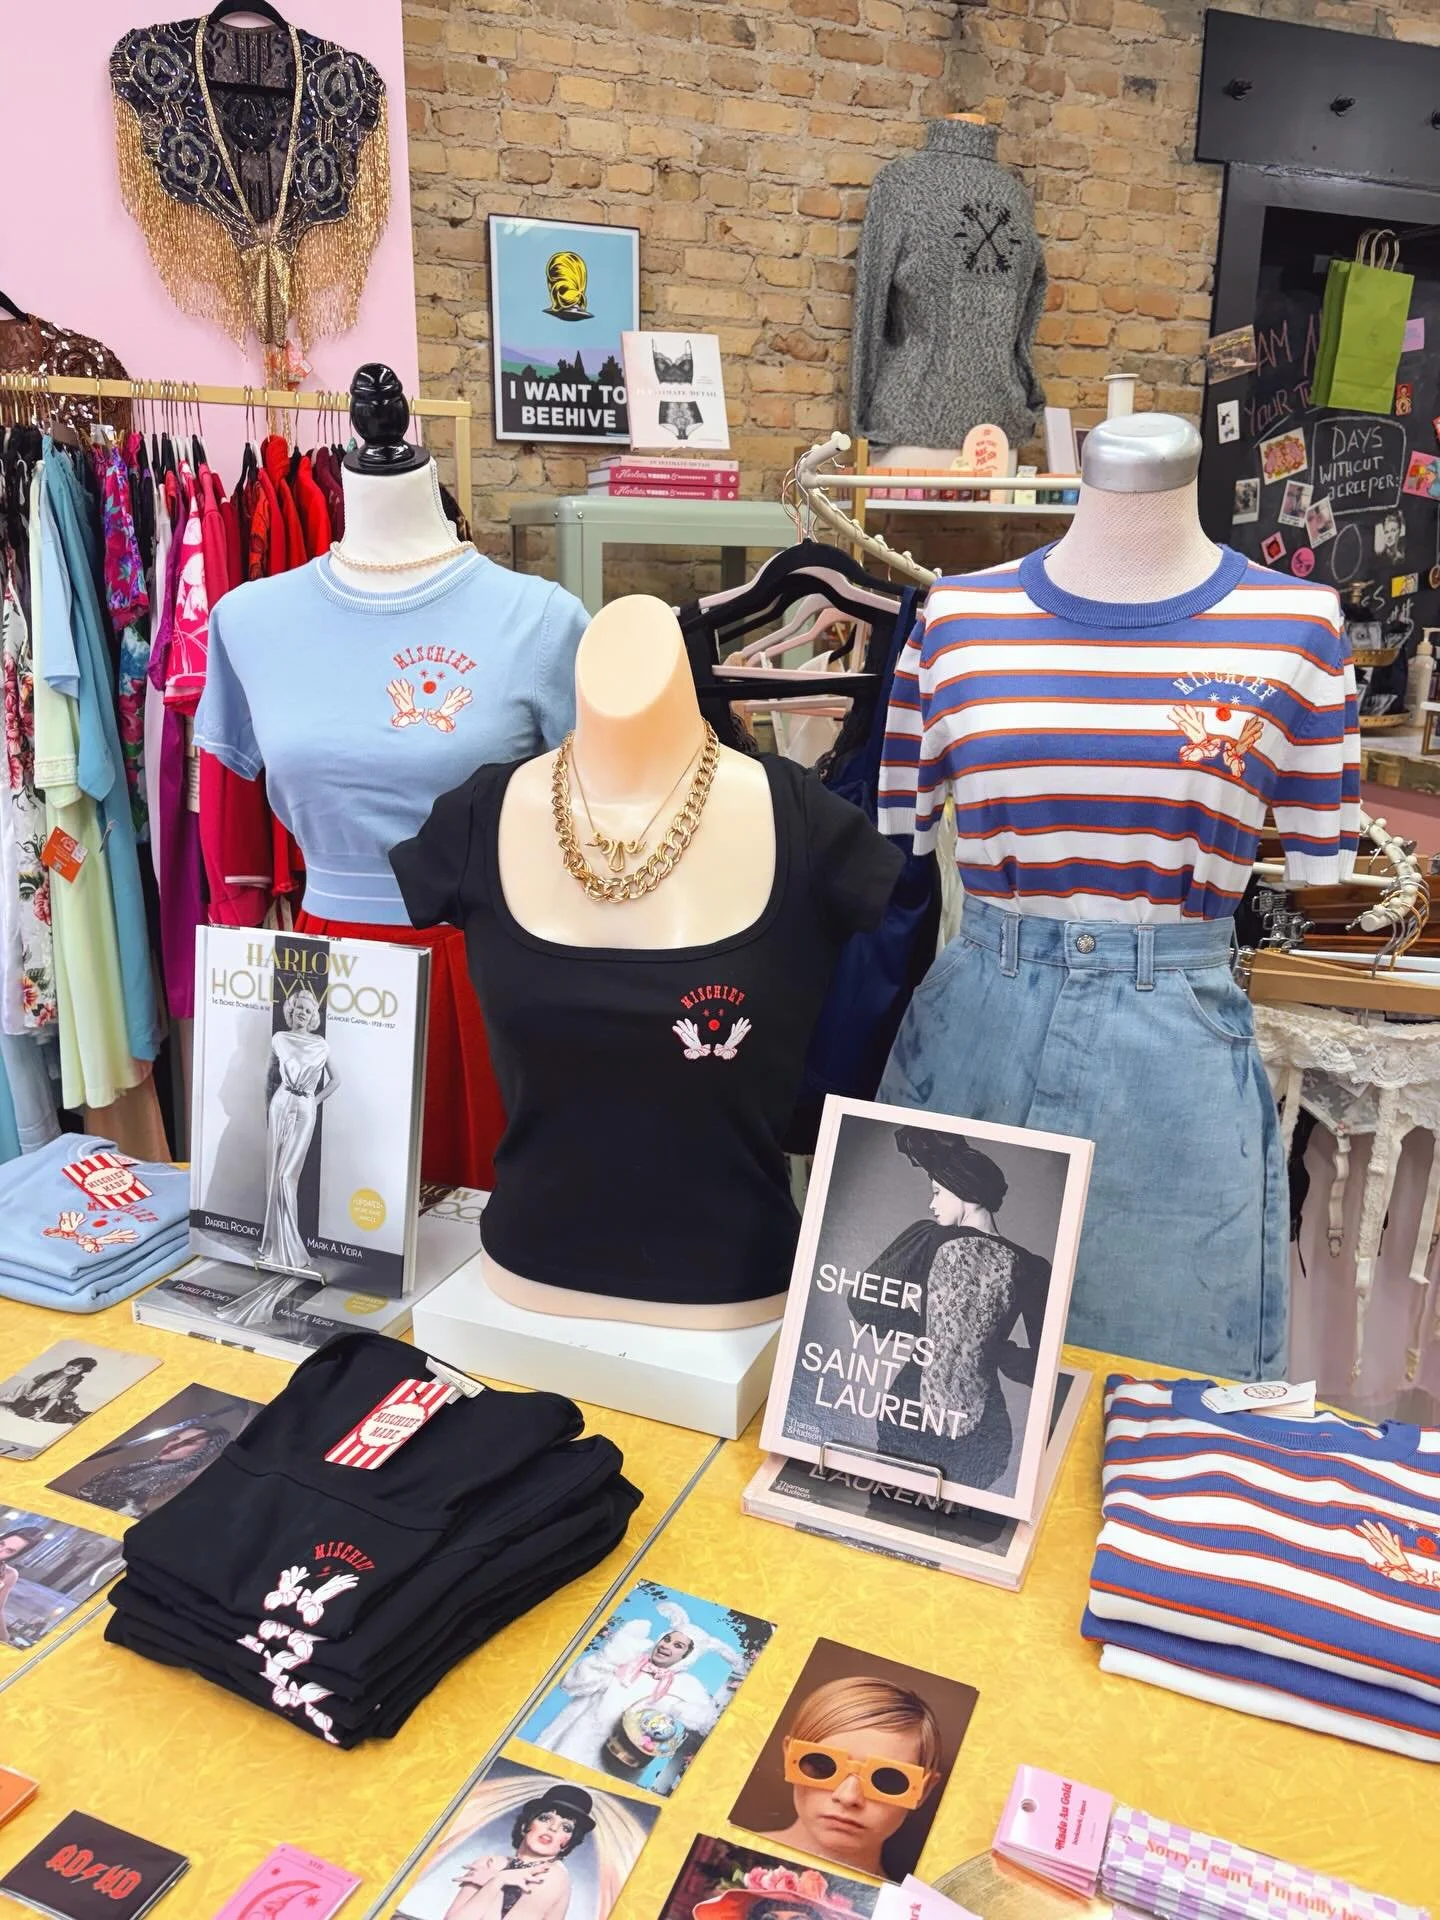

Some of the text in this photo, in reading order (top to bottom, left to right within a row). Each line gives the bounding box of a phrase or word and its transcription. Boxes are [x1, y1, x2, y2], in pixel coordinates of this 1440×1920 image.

[509, 380, 627, 405] I WANT TO
[521, 405, 617, 428] BEEHIVE
[1331, 425, 1384, 460] DAYS
[393, 645, 478, 674] MISCHIEF
[1172, 669, 1279, 701] MISCHIEF
[246, 942, 360, 979] HARLOW
[211, 967, 398, 1018] HOLLYWOOD
[680, 985, 745, 1010] MISCHIEF
[87, 1170, 125, 1189] MISCHIEF
[102, 1179, 128, 1192] MADE
[816, 1263, 922, 1317] SHEER
[848, 1319, 935, 1367] YVES
[801, 1342, 901, 1390] SAINT
[373, 1412, 421, 1428] MISCHIEF
[815, 1377, 969, 1441] LAURENT
[368, 1426, 401, 1440] MADE
[789, 1418, 820, 1433] Thames
[1144, 1839, 1196, 1870] Sorry,
